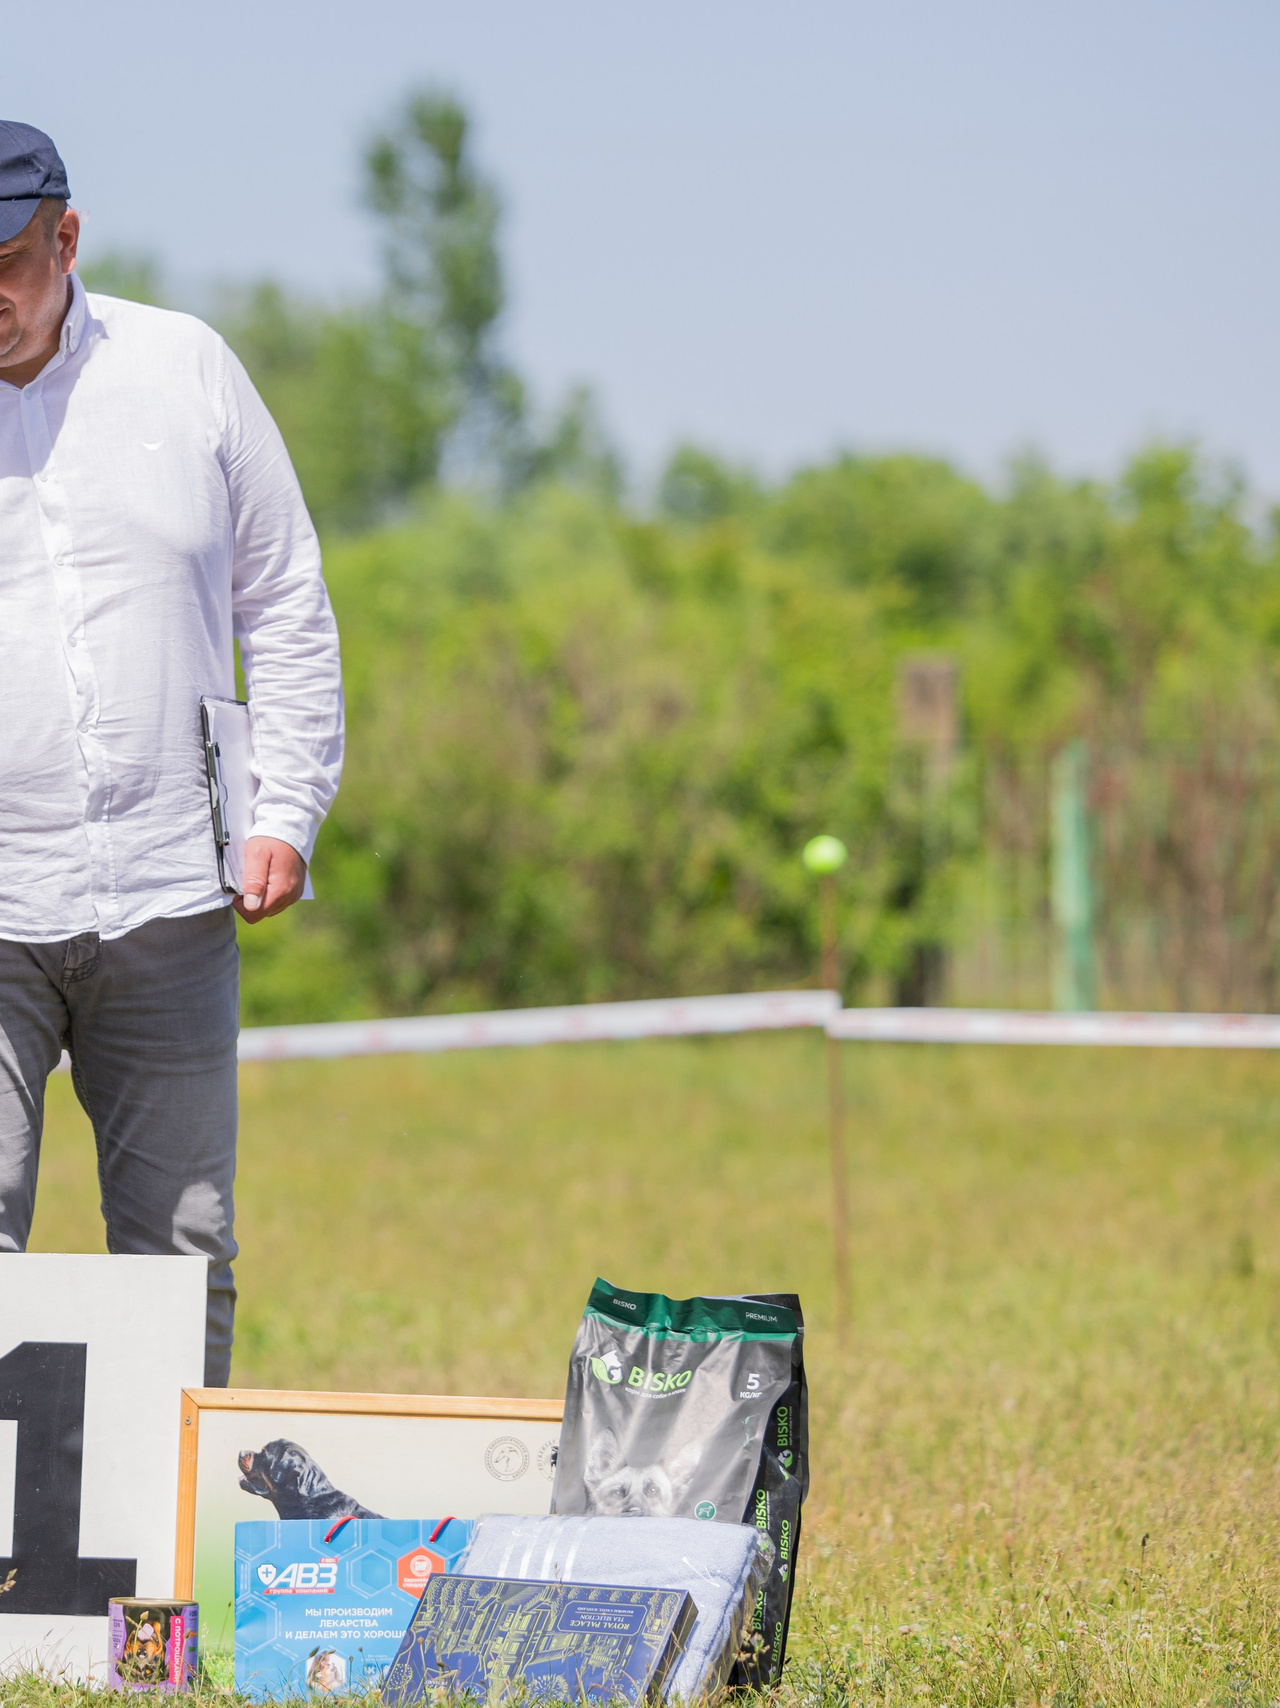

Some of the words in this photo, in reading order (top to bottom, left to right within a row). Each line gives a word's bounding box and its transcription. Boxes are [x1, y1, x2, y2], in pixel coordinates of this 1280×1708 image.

[612, 1298, 637, 1311] BISKO
[745, 1311, 778, 1323] PREMIUM
[627, 1366, 693, 1392] BISKO
[746, 1373, 760, 1390] 5
[776, 1406, 789, 1447] BISKO
[756, 1489, 767, 1530] BISKO
[780, 1519, 790, 1560] BISKO
[268, 1563, 338, 1588] АВЗ
[305, 1608, 322, 1617] МЫ
[324, 1607, 393, 1618] ПРОИЗВОДИМ
[319, 1619, 378, 1628] ЛЕКАРСТВА
[569, 1619, 601, 1628] PALACE
[603, 1622, 630, 1630] ROYAL
[285, 1630, 292, 1639] И
[294, 1630, 338, 1640] ДЕЛАЕМ
[340, 1630, 361, 1639] ЭТО
[771, 1621, 782, 1662] BISKO
